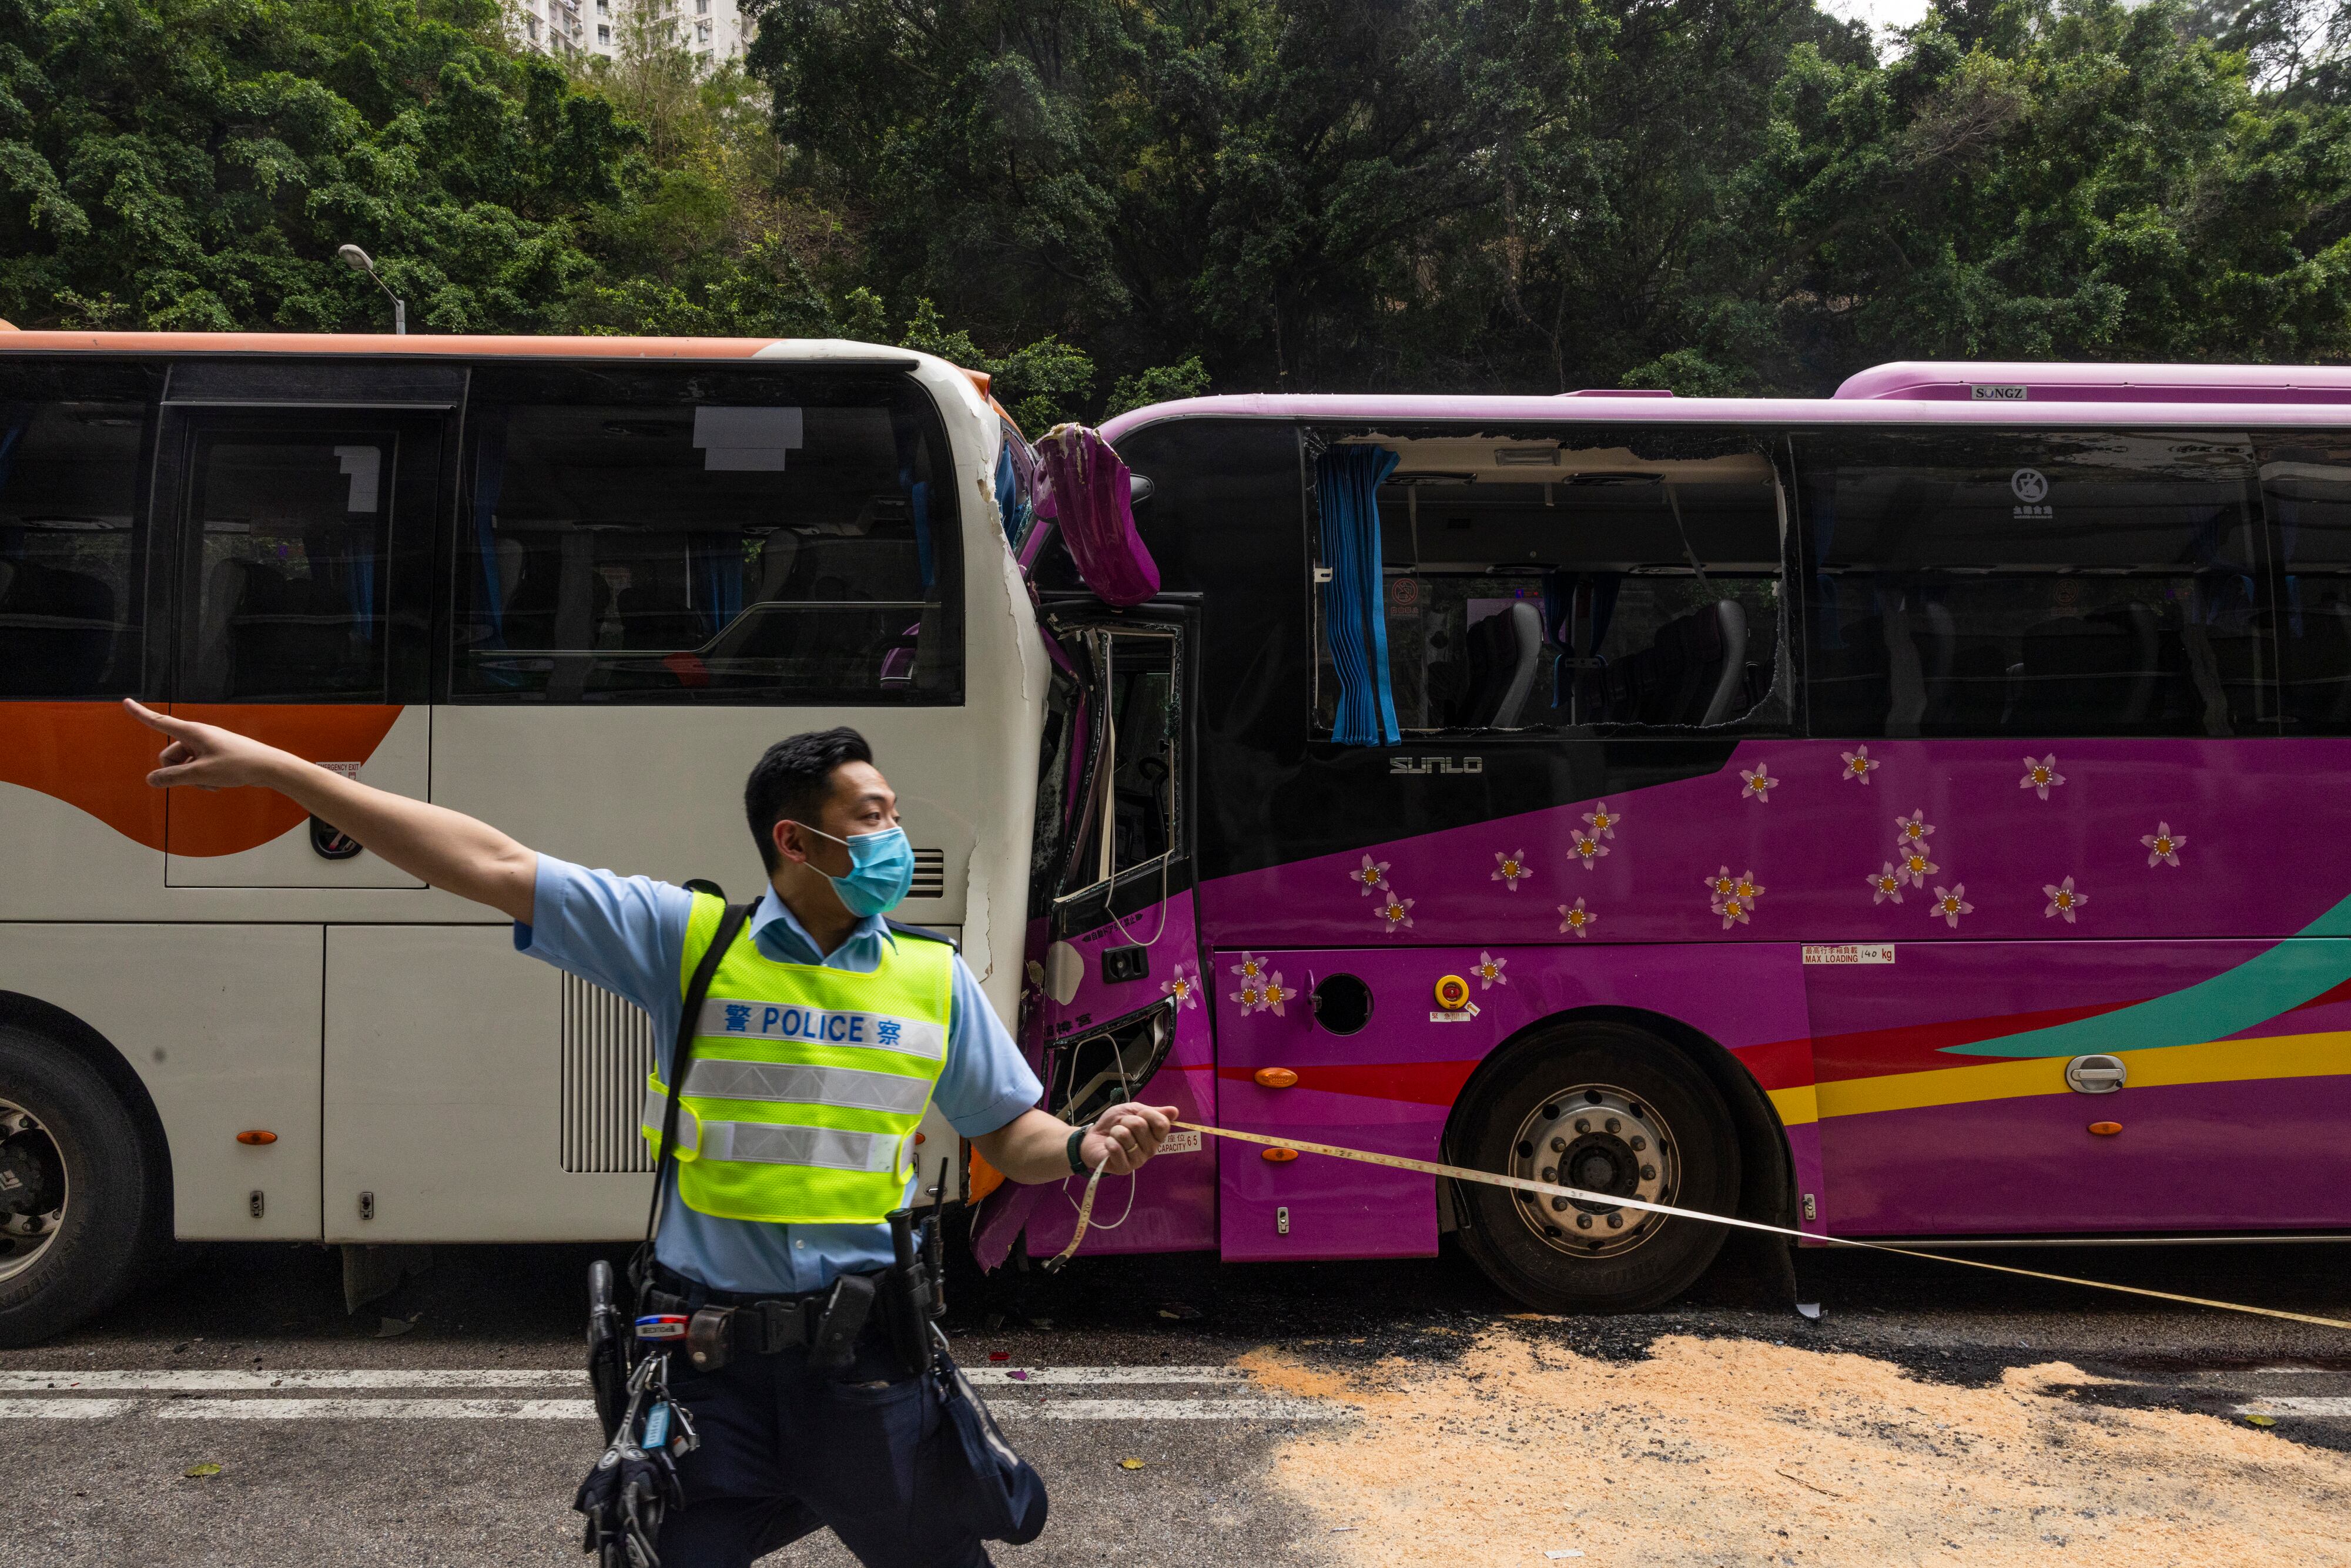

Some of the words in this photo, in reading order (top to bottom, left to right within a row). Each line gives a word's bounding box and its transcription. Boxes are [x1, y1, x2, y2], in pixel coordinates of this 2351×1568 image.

[1976, 388, 2023, 398] SONGZ
[1861, 950, 1877, 958] 140
[1882, 948, 1892, 961] kg
[724, 1004, 752, 1032] 警
[762, 1007, 864, 1043] POLICE
[876, 1020, 902, 1046] 察
[1157, 1143, 1186, 1152] CAPACITY
